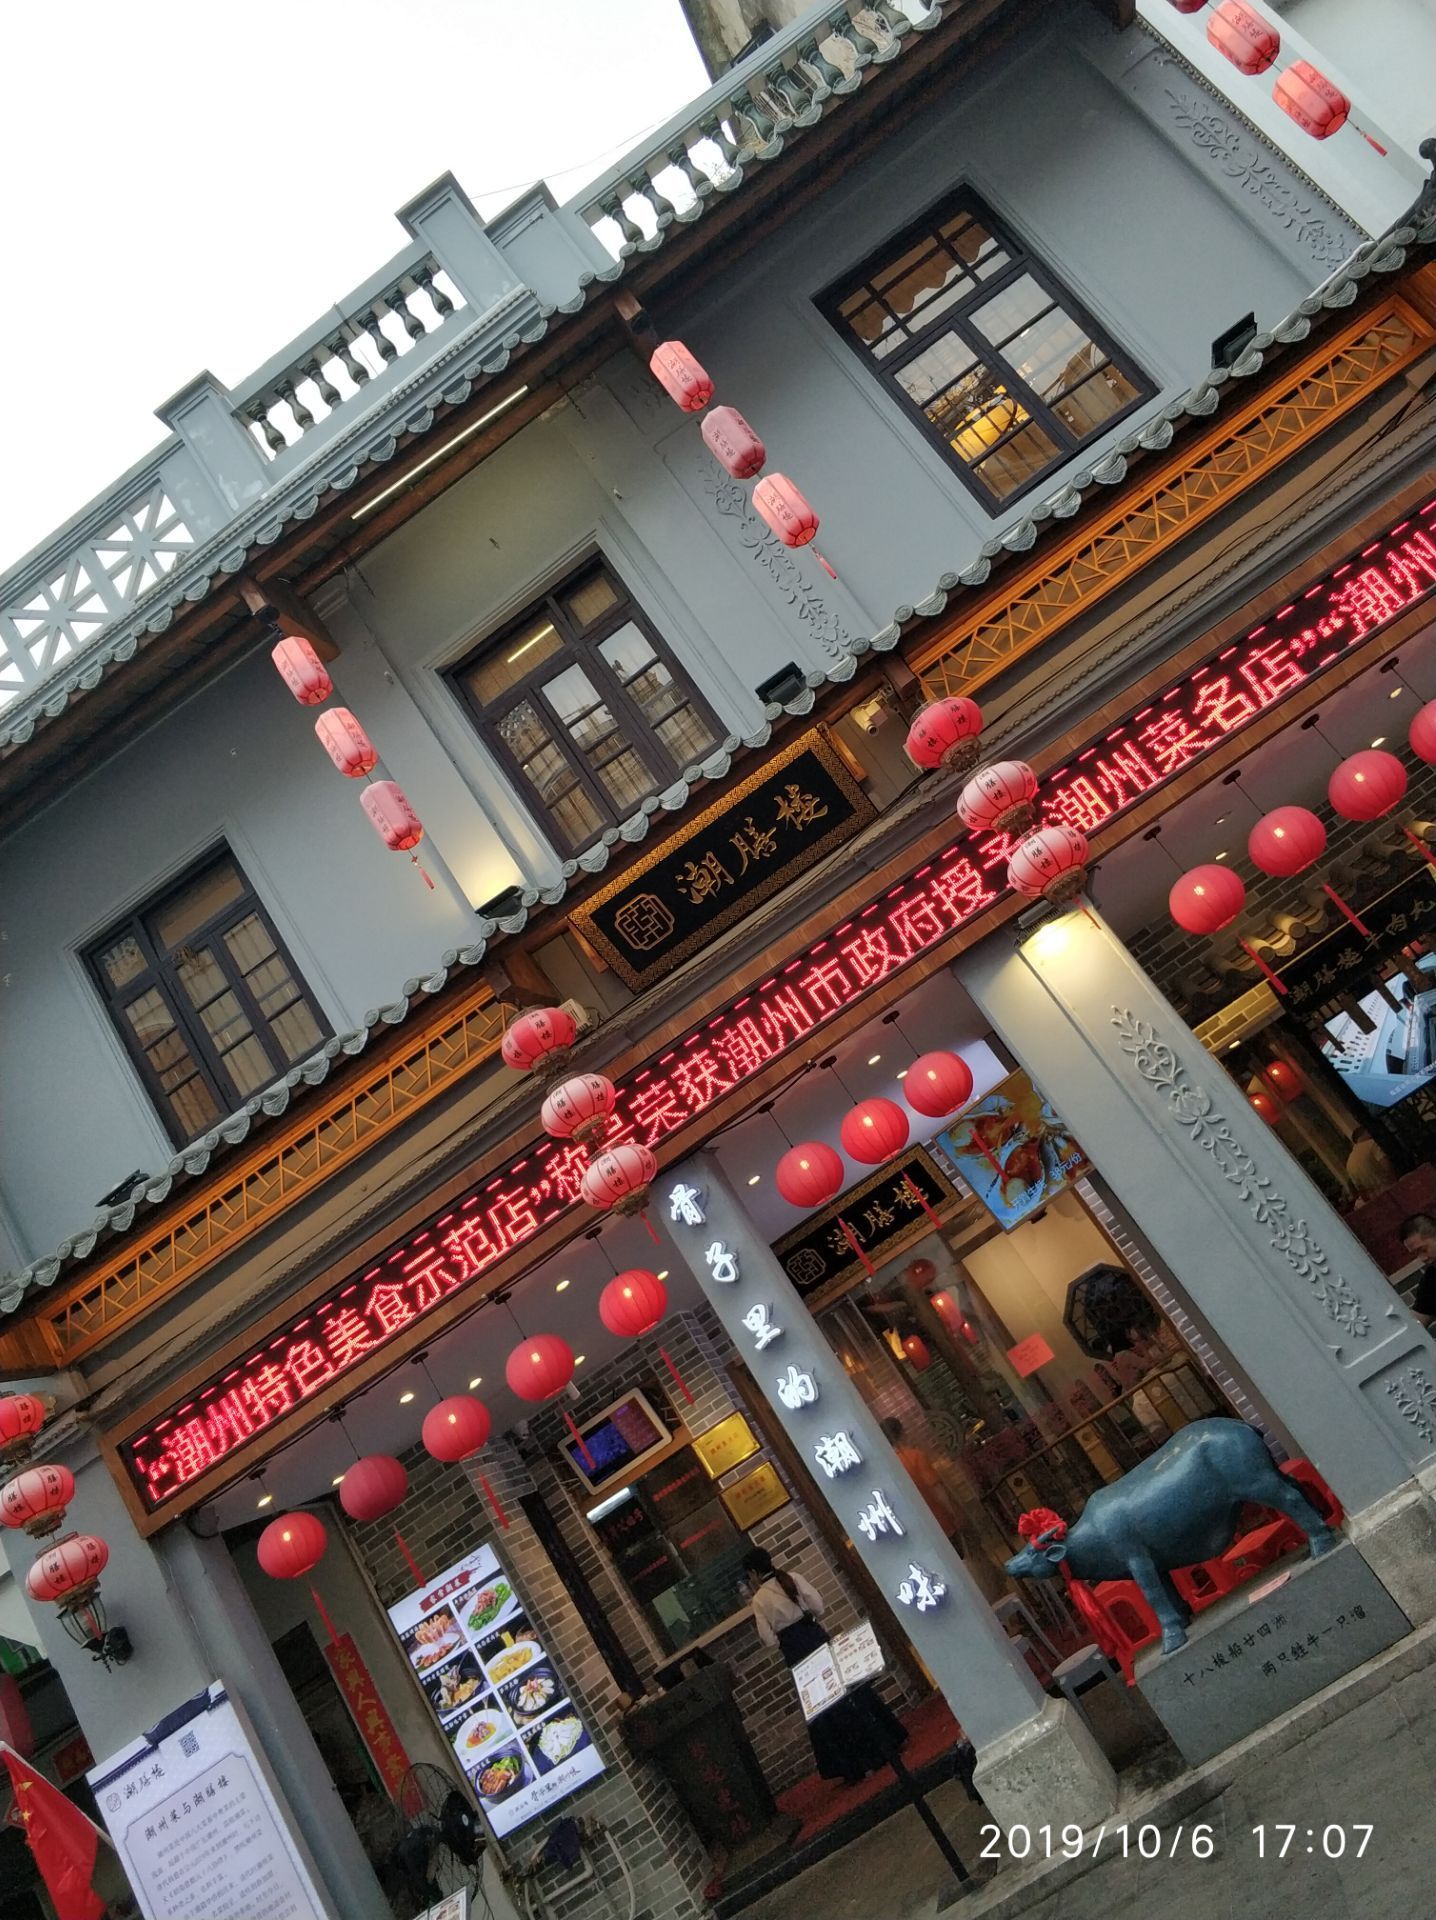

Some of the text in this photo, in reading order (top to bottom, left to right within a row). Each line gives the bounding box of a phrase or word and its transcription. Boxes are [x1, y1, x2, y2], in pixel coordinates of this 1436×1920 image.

[676, 783, 829, 906] 潮膳楼
[827, 1180, 929, 1254] 潮膳楼
